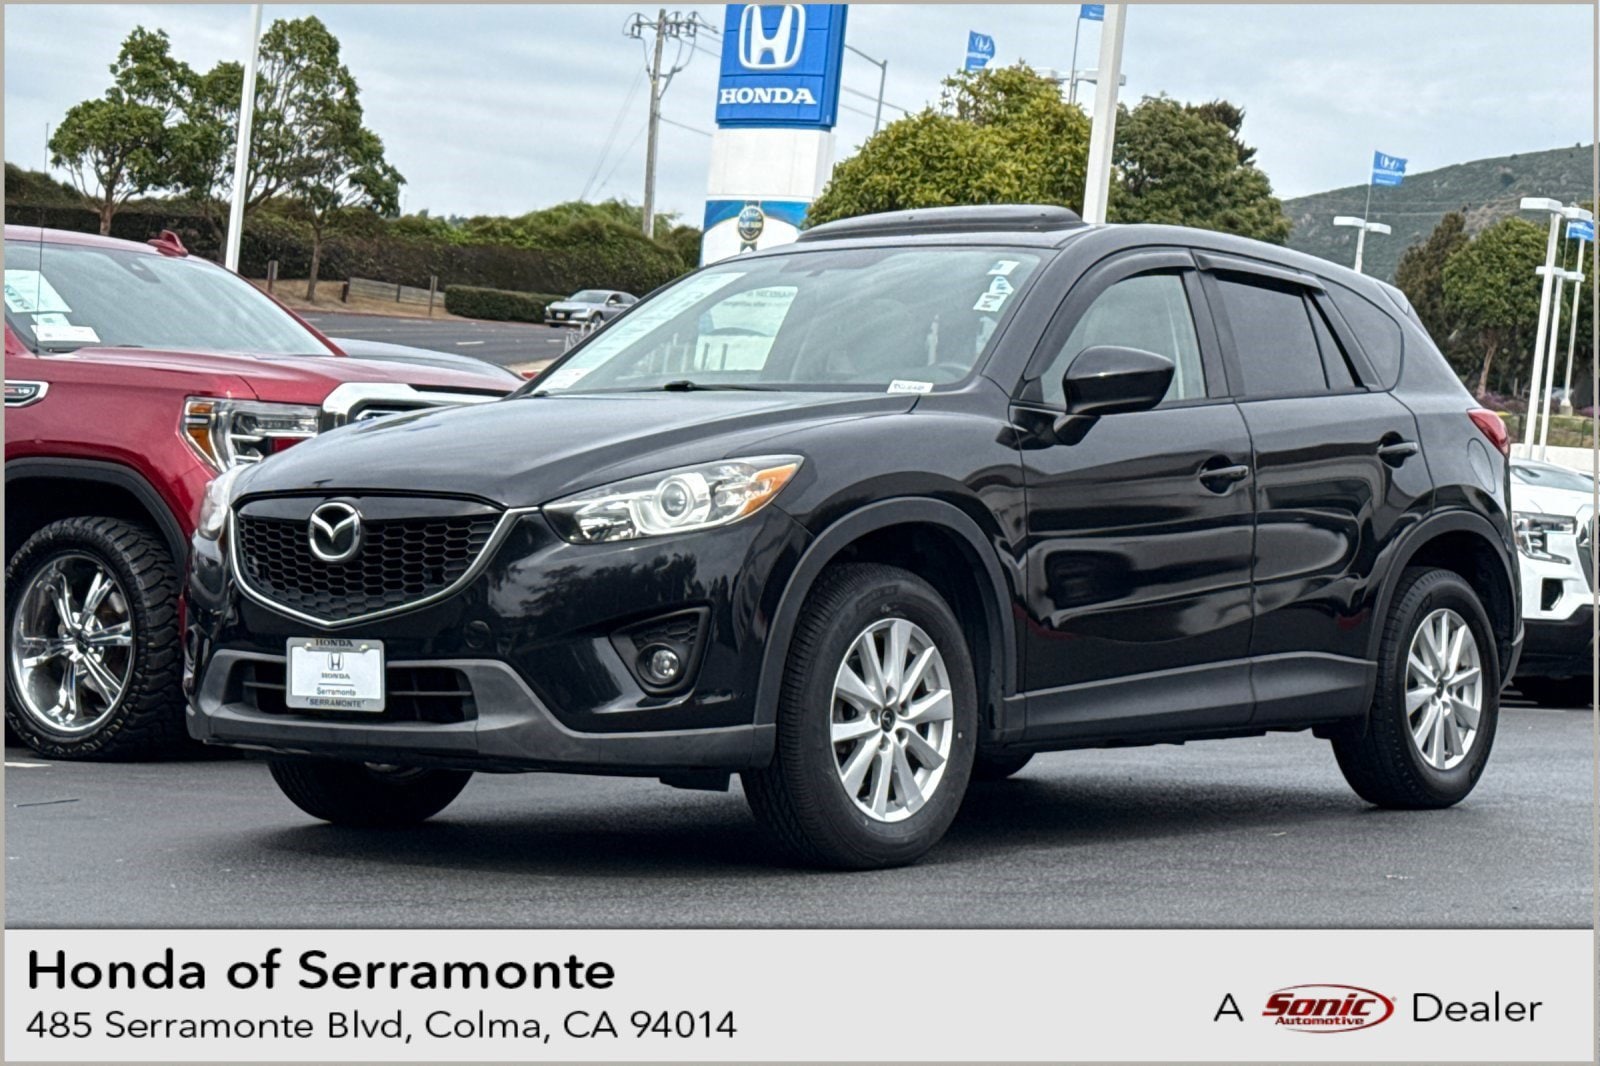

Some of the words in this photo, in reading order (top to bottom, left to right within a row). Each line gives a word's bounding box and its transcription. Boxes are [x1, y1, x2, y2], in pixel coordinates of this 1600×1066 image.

[719, 87, 817, 105] HONDA
[315, 639, 354, 647] HONDA
[316, 687, 357, 696] Serramonte
